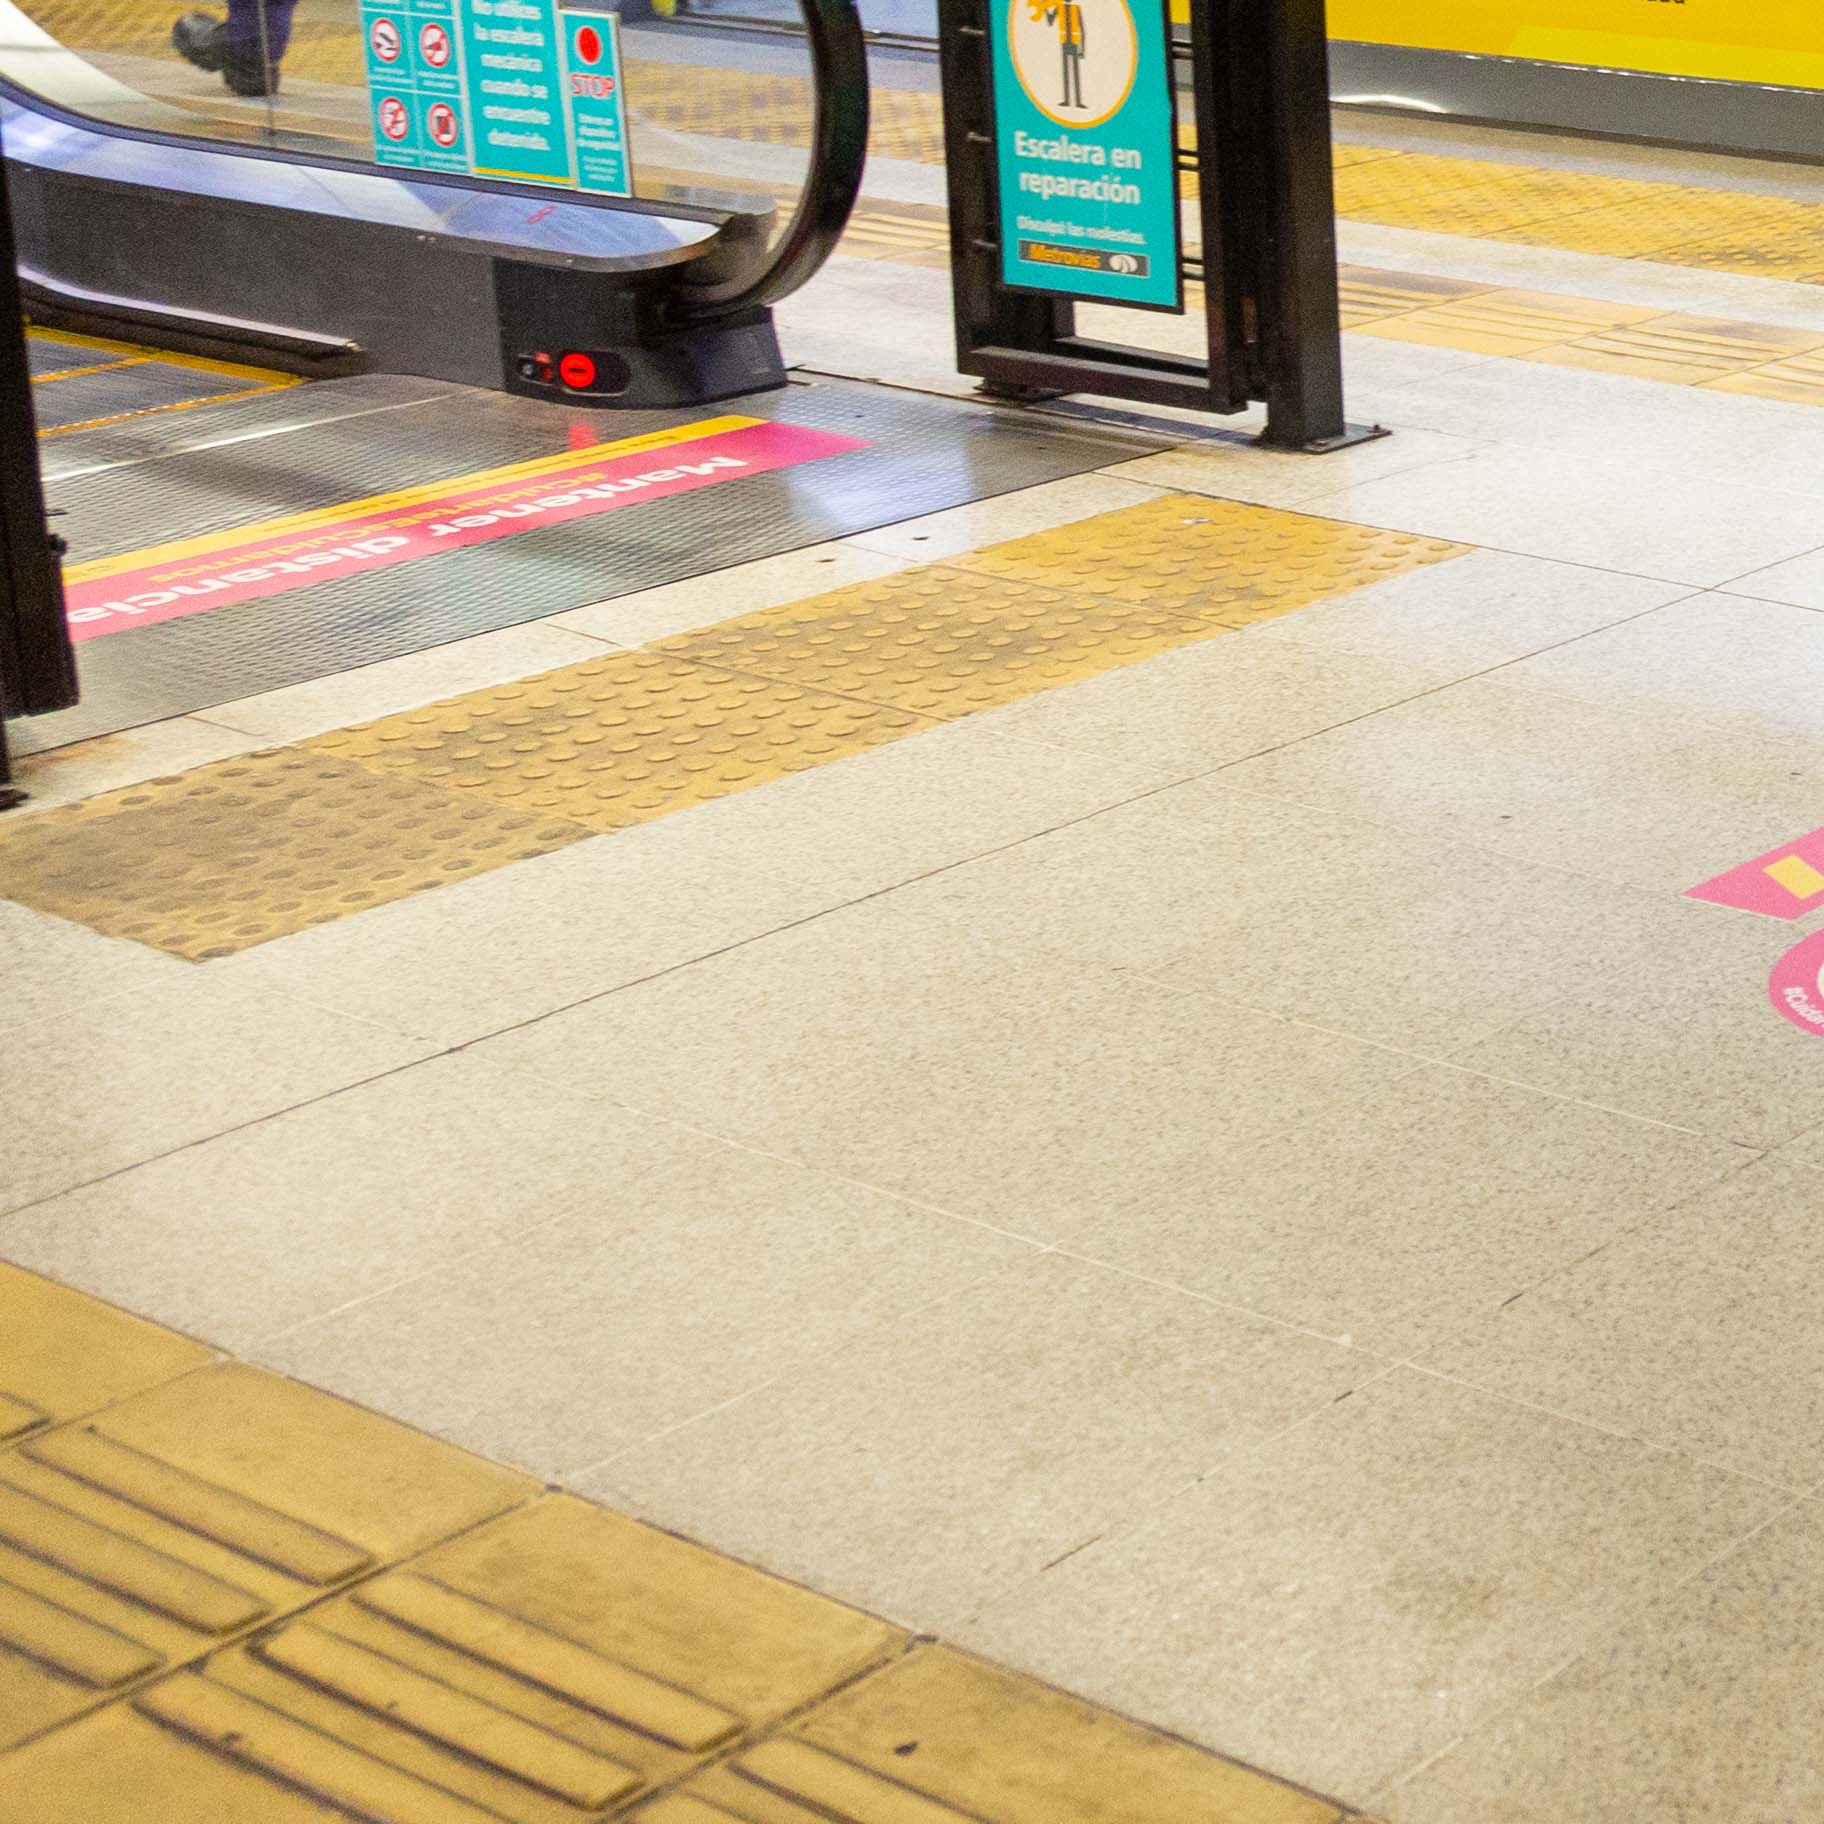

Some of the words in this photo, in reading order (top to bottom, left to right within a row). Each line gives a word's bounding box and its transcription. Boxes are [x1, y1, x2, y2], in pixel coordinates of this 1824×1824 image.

[571, 72, 616, 100] STOP
[1013, 129, 1107, 166] Escalera
[1111, 147, 1142, 169] en
[1019, 172, 1141, 205] reparación
[427, 456, 749, 538] Mantener
[66, 535, 411, 624] distancia
